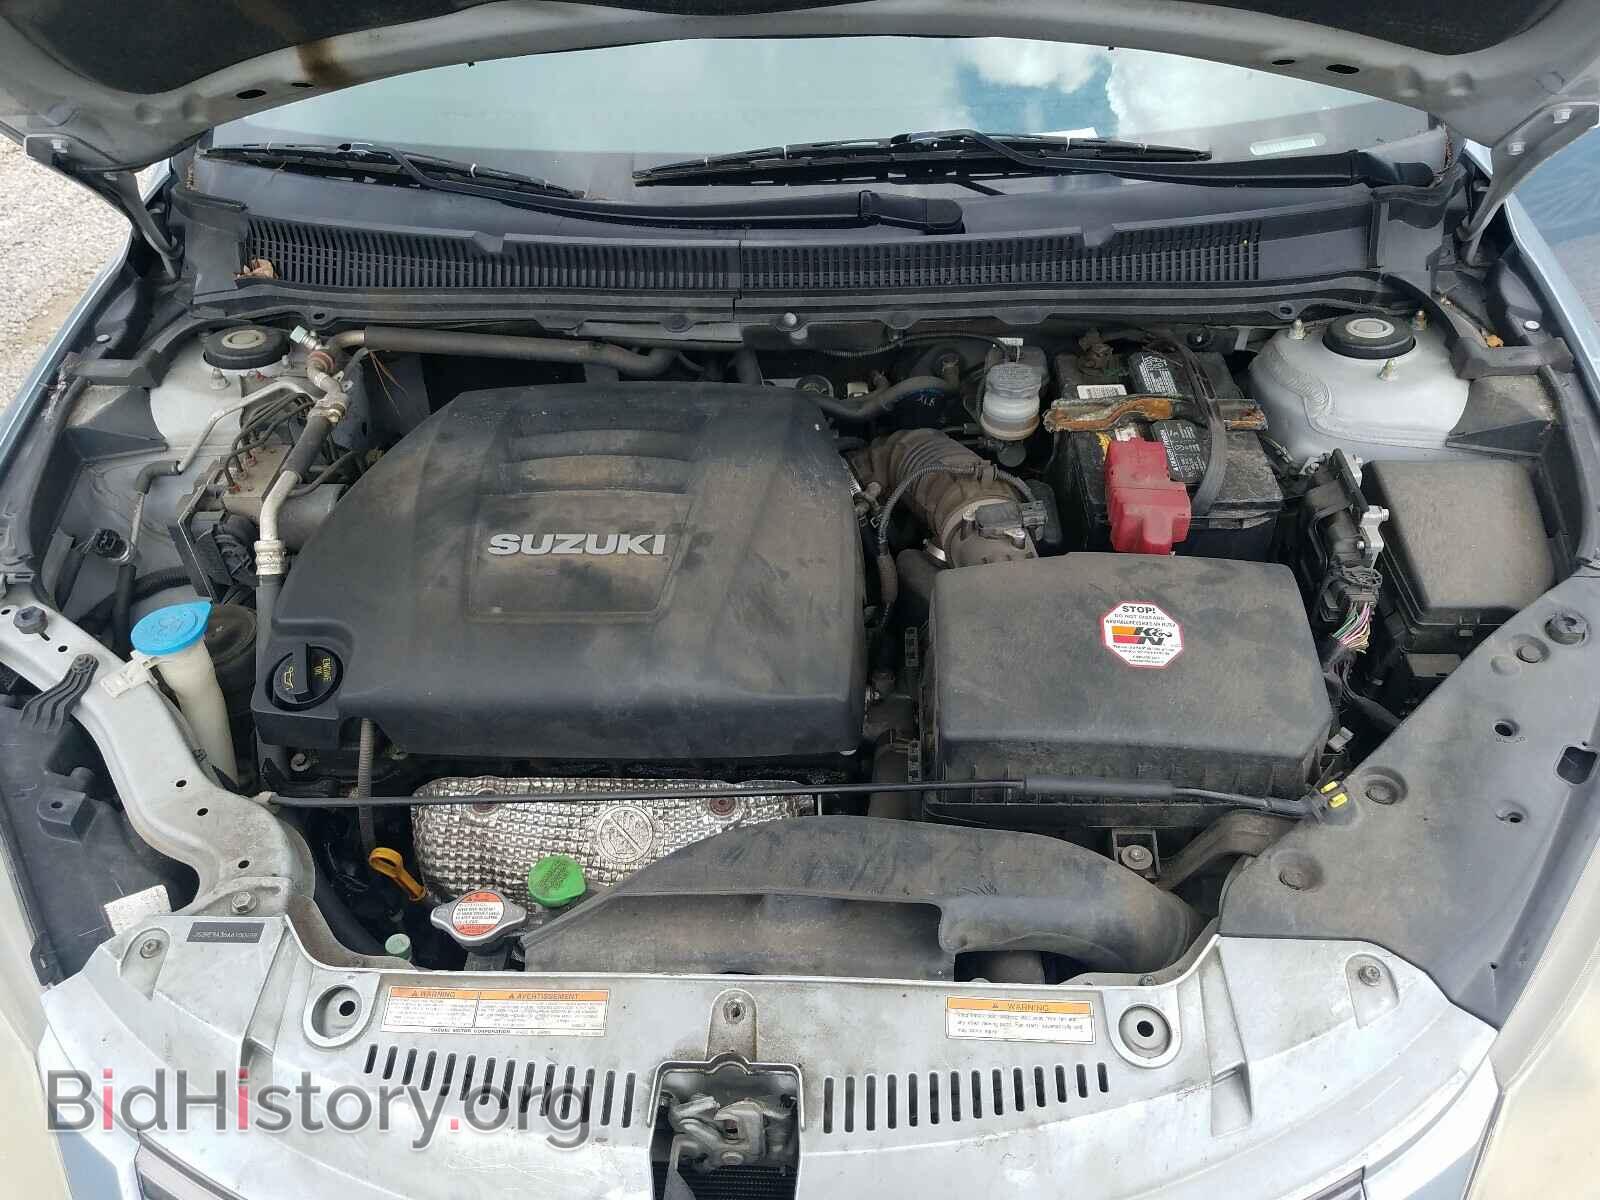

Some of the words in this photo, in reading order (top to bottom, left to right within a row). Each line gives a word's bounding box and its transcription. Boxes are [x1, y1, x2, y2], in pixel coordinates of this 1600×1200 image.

[487, 533, 666, 555] SUZUKI
[1122, 605, 1156, 614] STOP!
[420, 990, 455, 999] WARNING
[1007, 1002, 1050, 1012] WARNING
